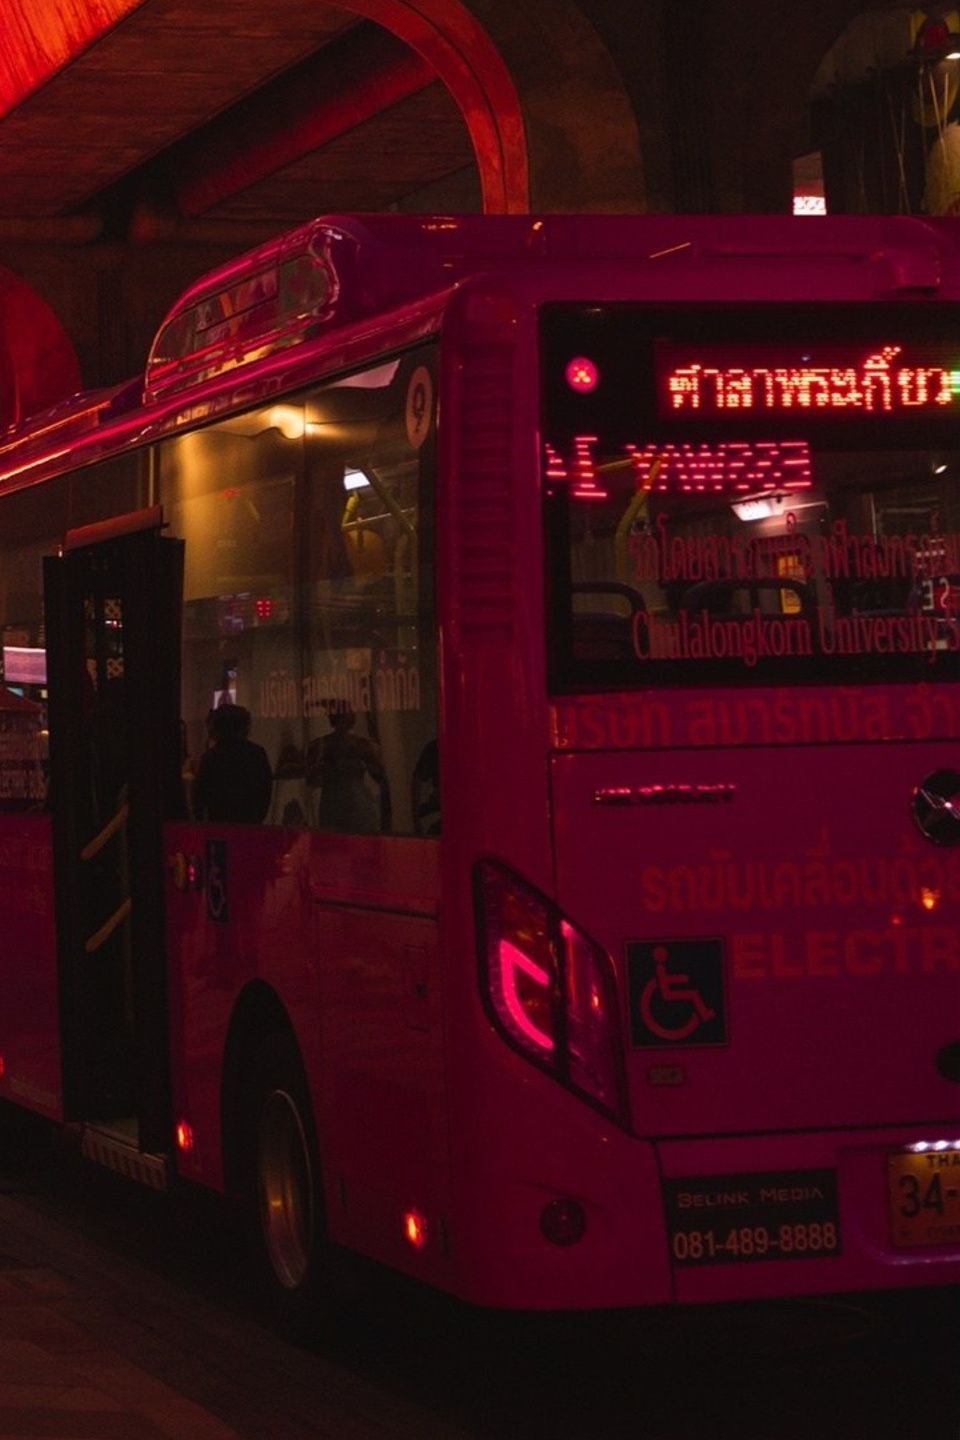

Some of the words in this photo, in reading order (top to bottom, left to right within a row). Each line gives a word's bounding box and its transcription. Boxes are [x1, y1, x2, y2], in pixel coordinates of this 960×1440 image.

[632, 606, 813, 667] Chulalongkorn
[816, 606, 940, 665] University
[677, 1191, 750, 1208] BELINK
[759, 1187, 825, 1203] MEDIA
[673, 1222, 838, 1260] 081-489-8888
